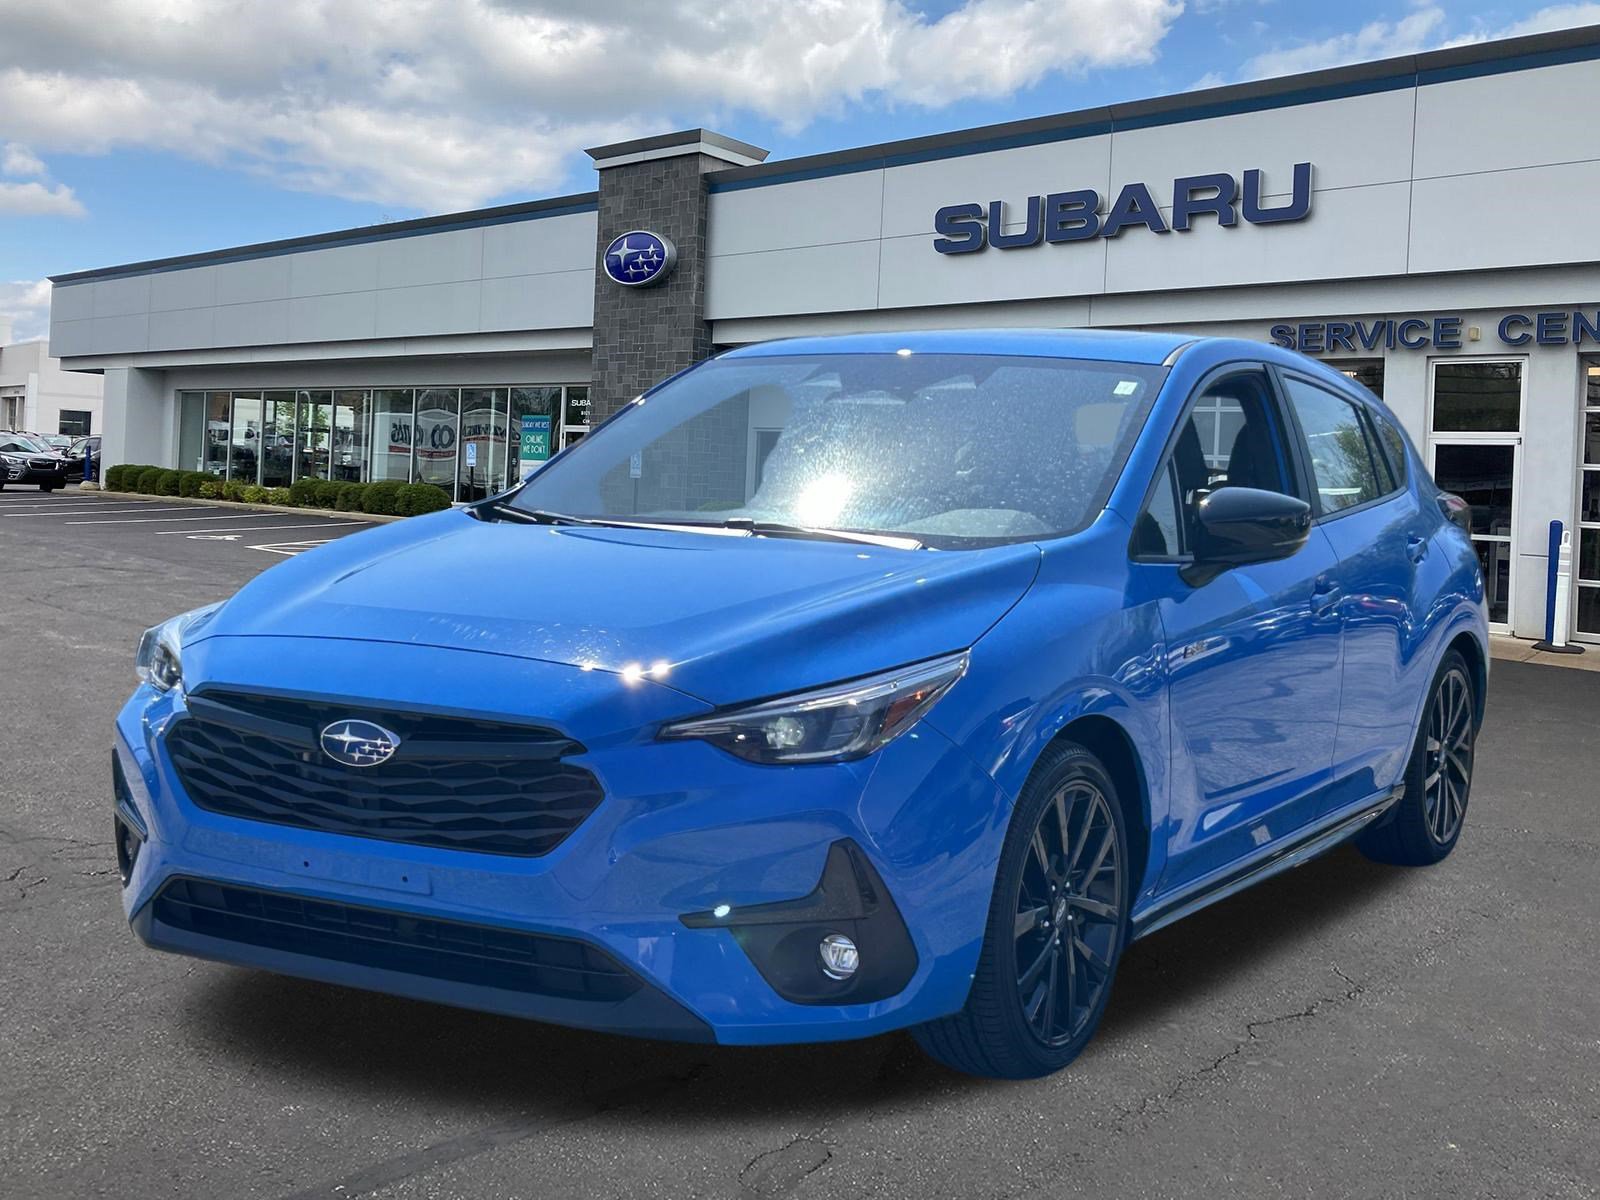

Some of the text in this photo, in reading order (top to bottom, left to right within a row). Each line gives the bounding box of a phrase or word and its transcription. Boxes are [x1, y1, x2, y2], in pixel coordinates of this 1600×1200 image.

[933, 161, 1313, 256] SUBARU
[1270, 311, 1600, 351] SERVICE CEN
